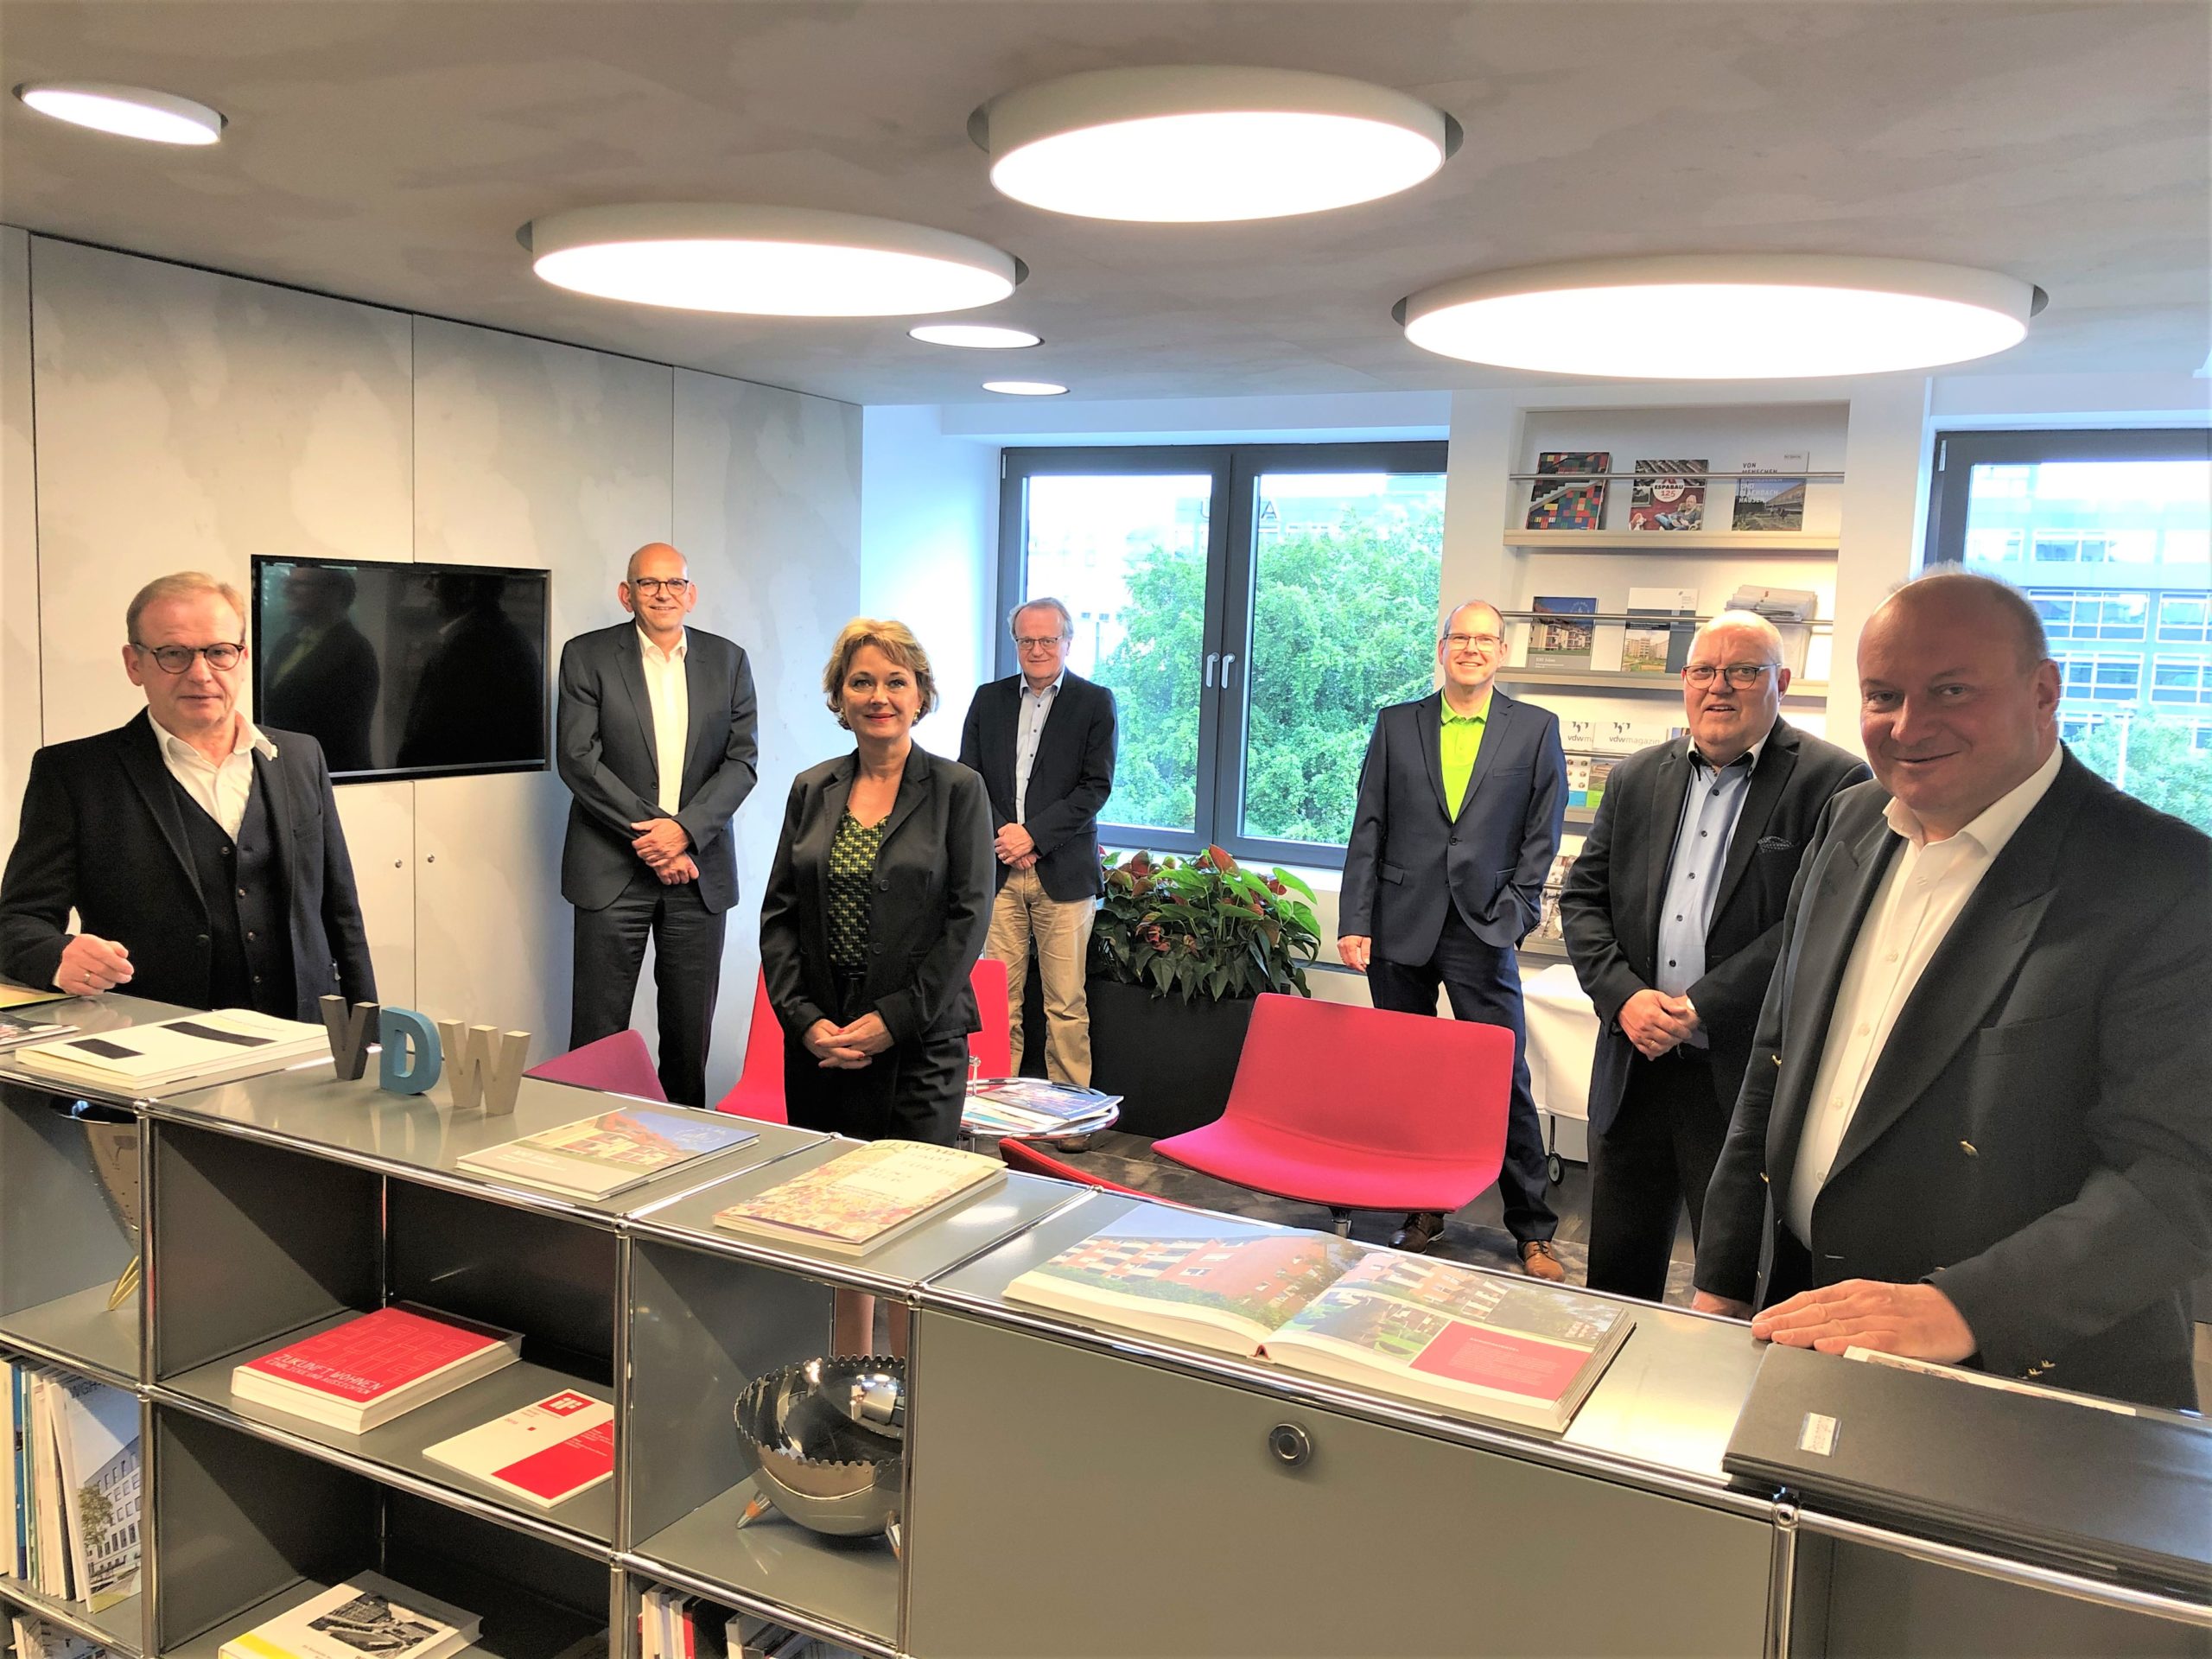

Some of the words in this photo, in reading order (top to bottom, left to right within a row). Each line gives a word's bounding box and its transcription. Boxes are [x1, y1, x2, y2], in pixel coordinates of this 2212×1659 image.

[1567, 734, 1593, 743] vdwm
[1609, 735, 1661, 747] vdwmagazin
[273, 1353, 335, 1375] ZUKUNFT
[328, 1370, 384, 1390] WOHNEN
